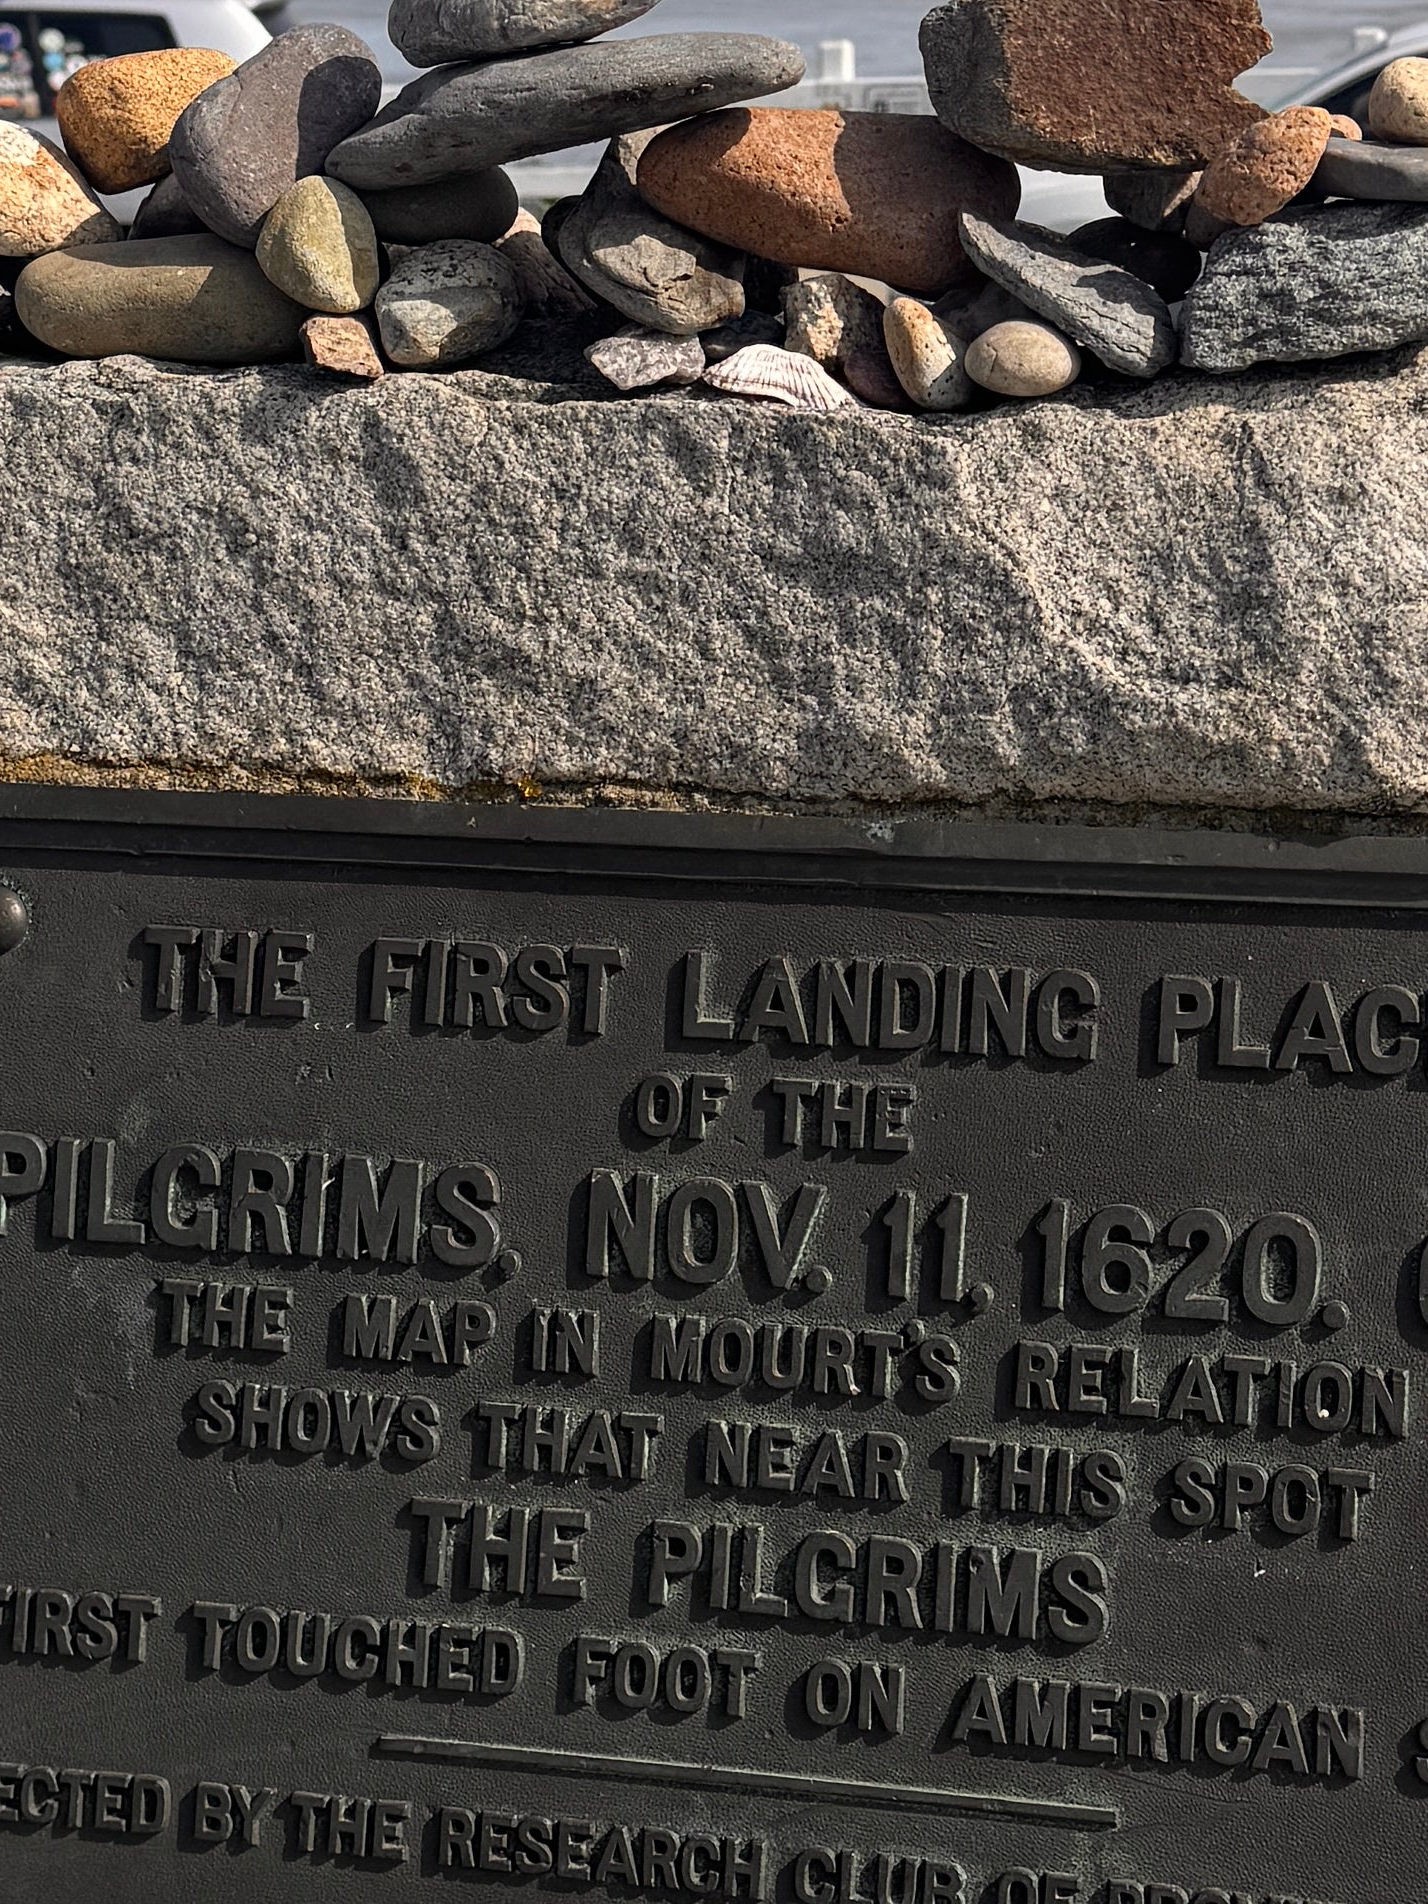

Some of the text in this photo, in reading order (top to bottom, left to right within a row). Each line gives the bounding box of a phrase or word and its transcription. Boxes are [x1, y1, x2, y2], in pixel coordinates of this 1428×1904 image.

[143, 924, 314, 1020] THE
[370, 936, 625, 1036] FIRST
[684, 949, 1102, 1062] LANDING
[636, 1071, 917, 1151] OF THE
[585, 1167, 834, 1296] NOV.
[1036, 1197, 1351, 1330] 1620.
[161, 1278, 1412, 1439] THE MAP IN MOURT'S RELATION
[193, 1379, 1376, 1542] SHOWS THAT NEAR THIS SPOT
[410, 1498, 1111, 1644] THE PILGRIMS
[192, 1600, 527, 1697] TOUCHED
[573, 1635, 761, 1719] FOOT
[805, 1657, 907, 1736] ON
[952, 1672, 1368, 1781] AMERICAN
[192, 1780, 278, 1849] BY
[292, 1790, 414, 1863] THE
[437, 1805, 770, 1900] RESEARCH
